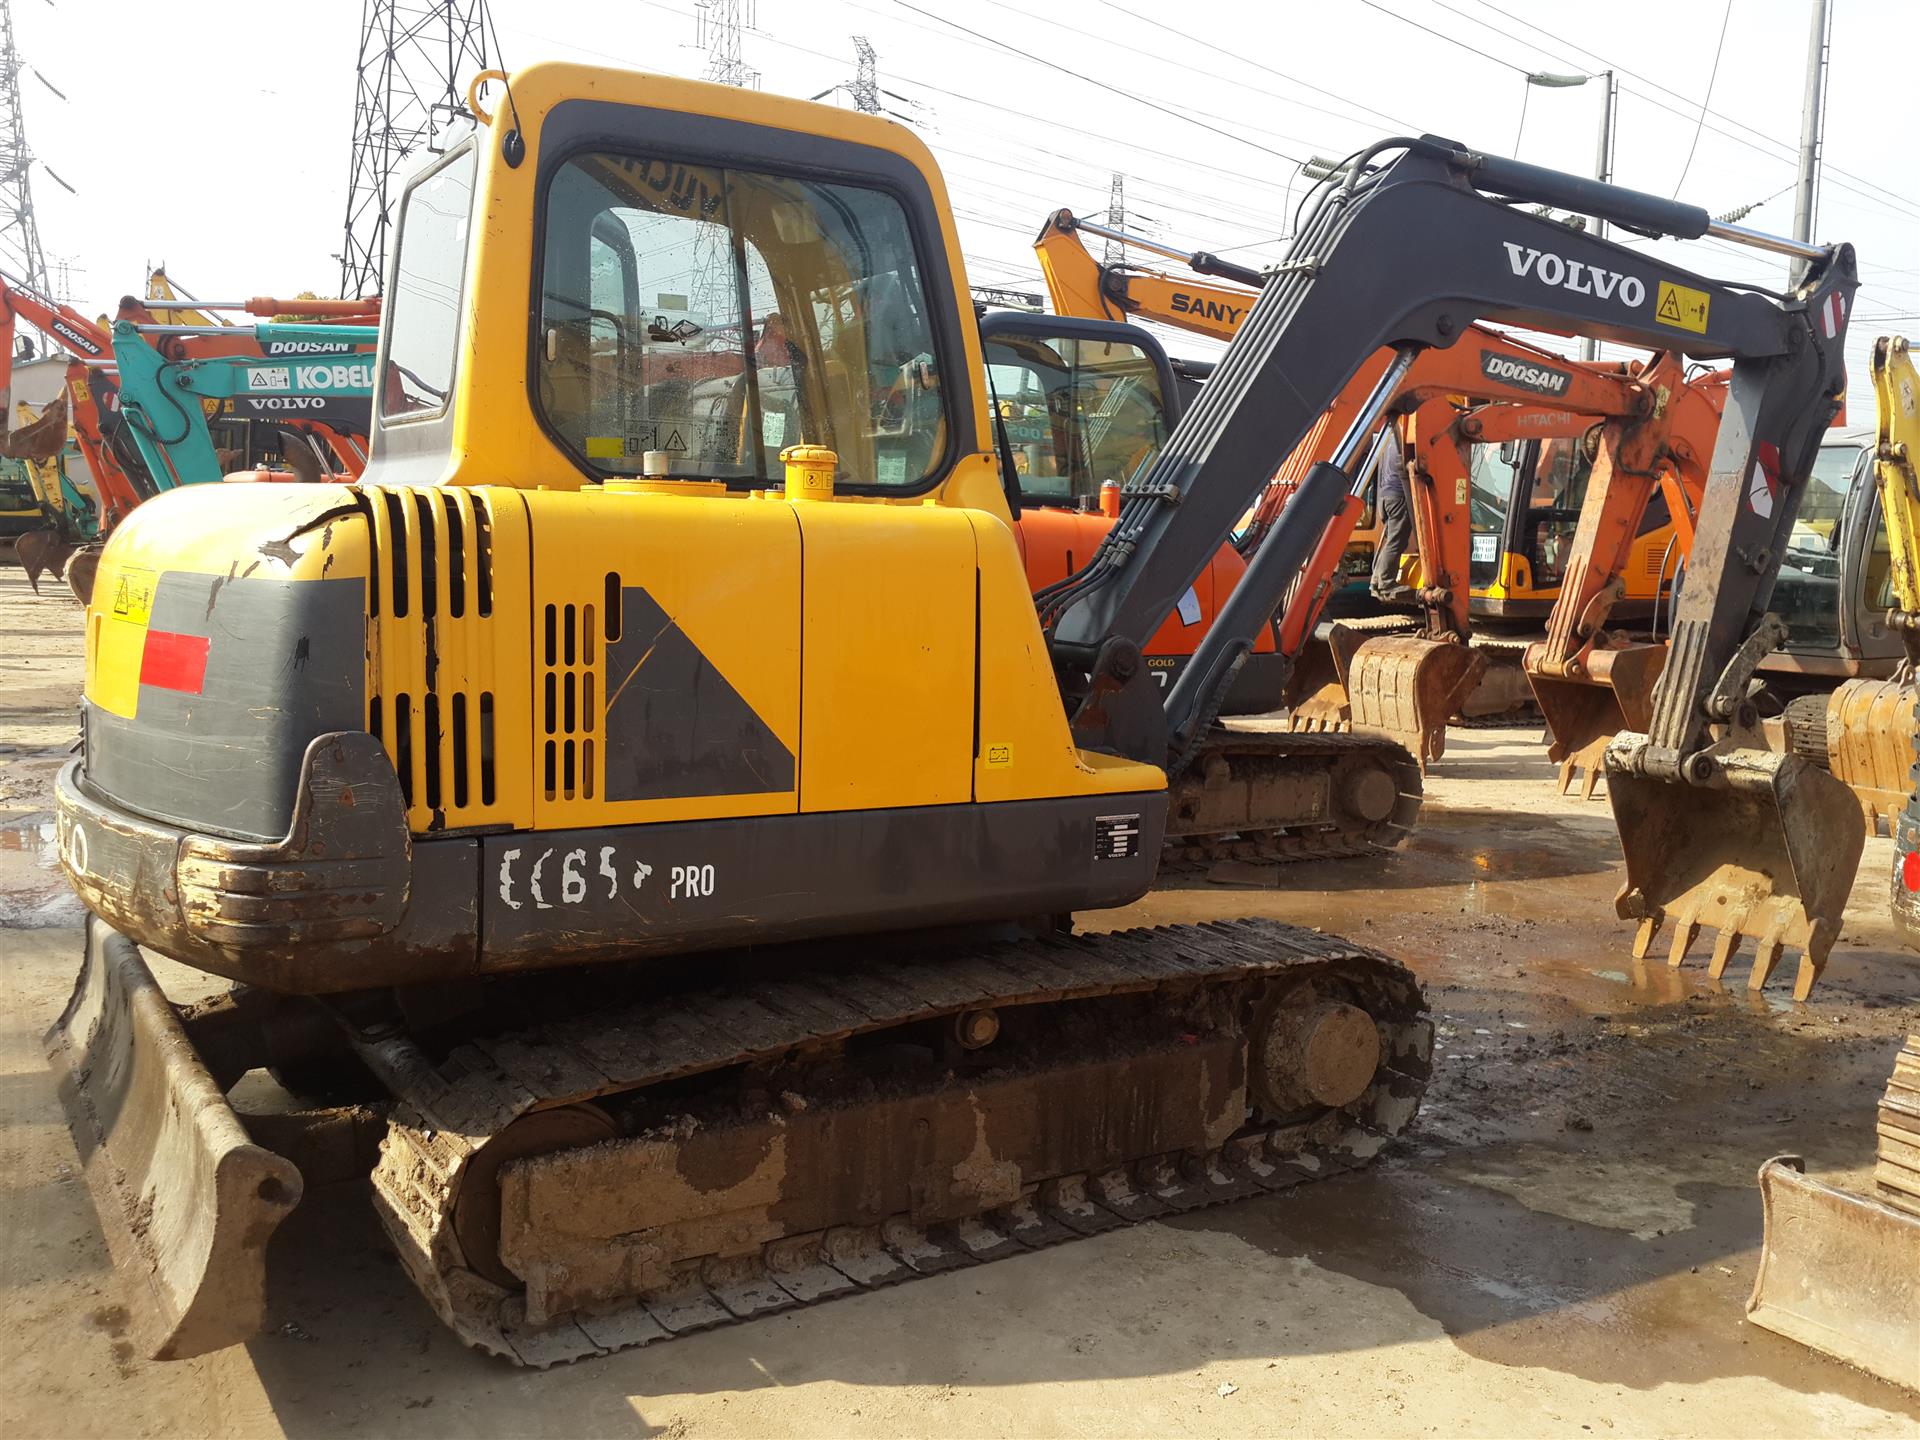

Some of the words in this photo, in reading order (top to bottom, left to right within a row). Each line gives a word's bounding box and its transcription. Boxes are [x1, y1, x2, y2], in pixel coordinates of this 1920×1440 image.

[1503, 241, 1646, 308] VOLVO
[1170, 293, 1242, 325] SANY
[53, 322, 100, 355] DOOSAN
[270, 341, 349, 354] DOOSAN
[1487, 357, 1565, 391] DOOSAN
[248, 397, 326, 410] VOLVO
[1517, 412, 1572, 428] HITACHI
[1147, 658, 1175, 668] GOLD
[670, 864, 715, 899] PRO
